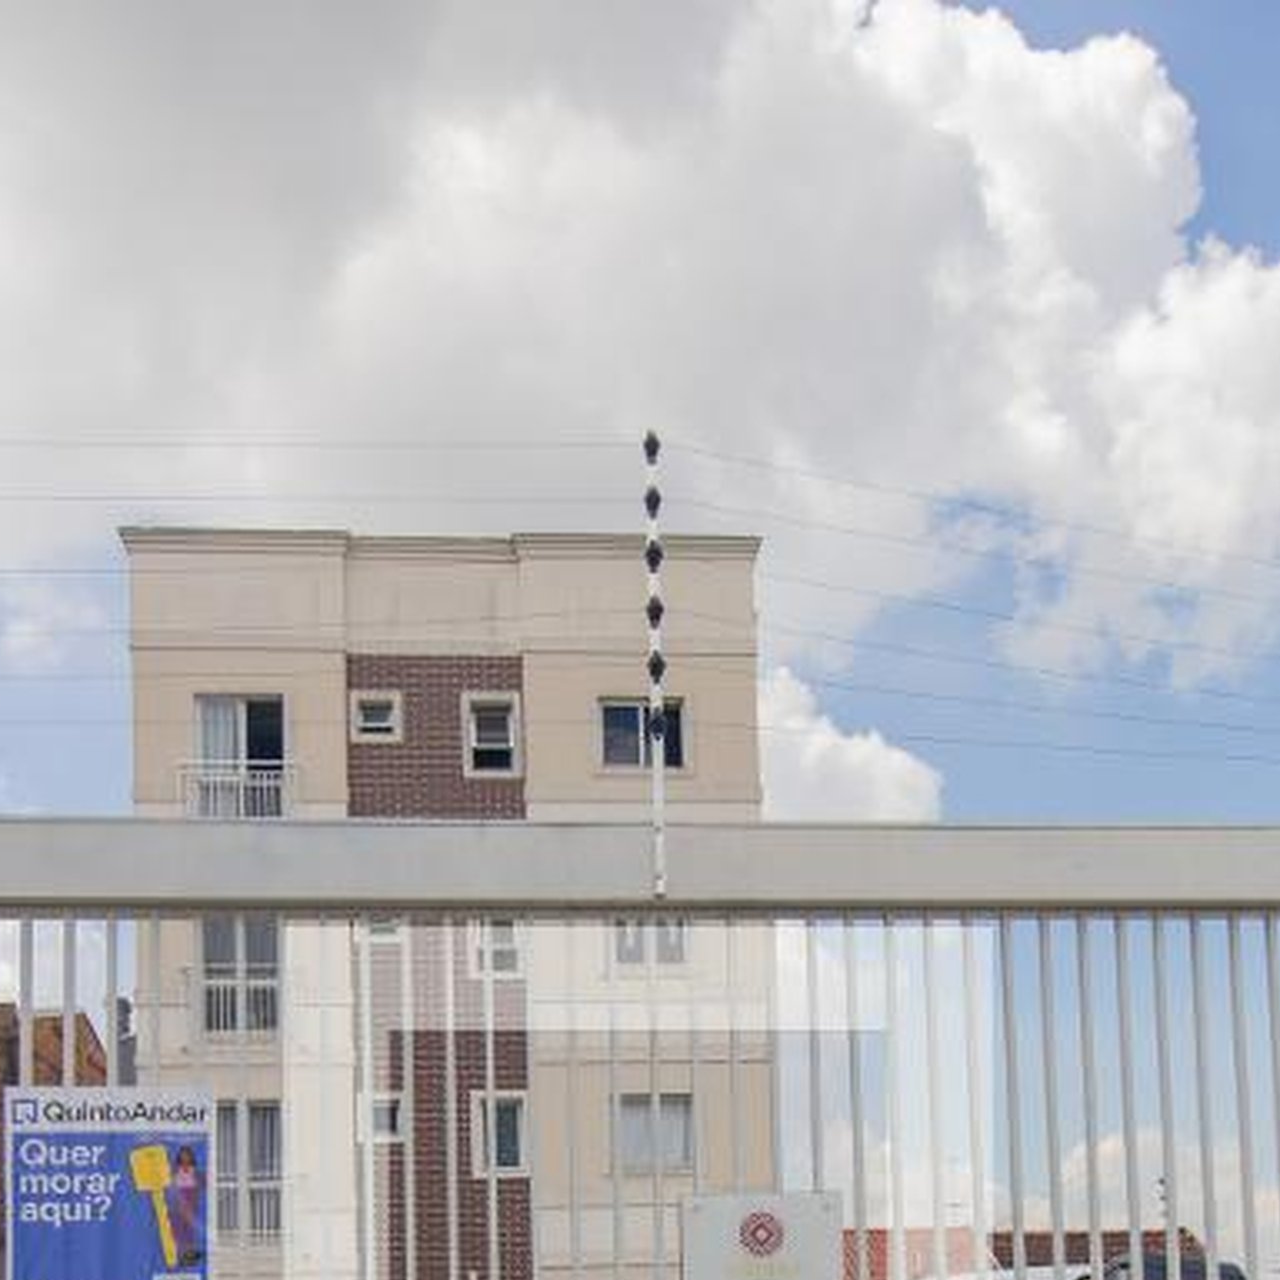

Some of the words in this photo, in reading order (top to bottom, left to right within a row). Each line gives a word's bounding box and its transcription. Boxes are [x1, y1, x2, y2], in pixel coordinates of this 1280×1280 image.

[43, 1101, 206, 1123] QuintoAndar
[20, 1139, 106, 1167] Quer
[20, 1171, 120, 1195] morar
[20, 1196, 111, 1228] aqui?
